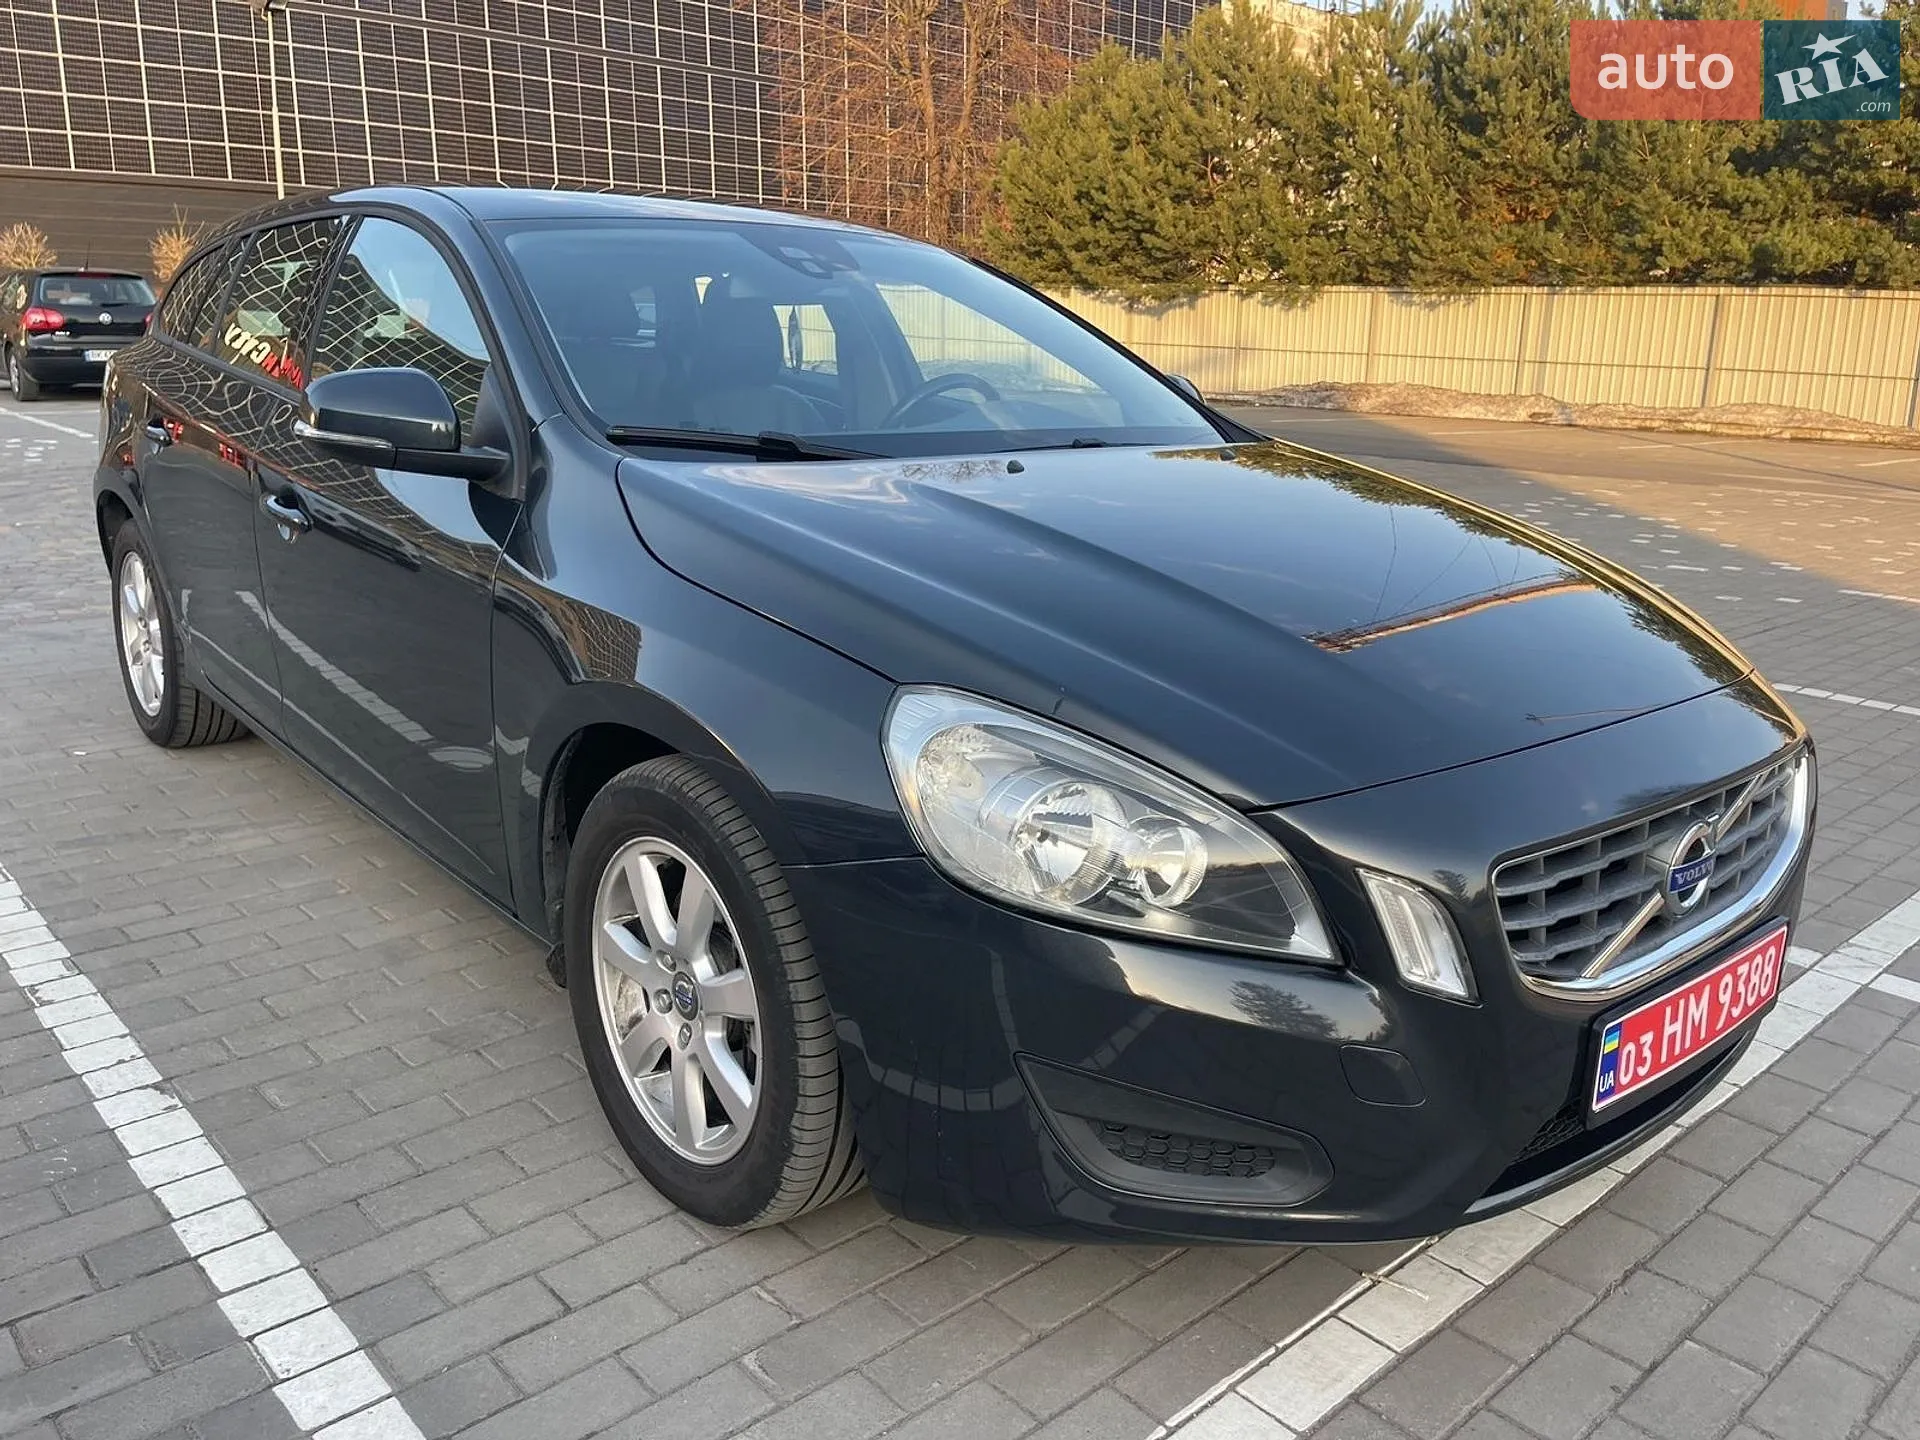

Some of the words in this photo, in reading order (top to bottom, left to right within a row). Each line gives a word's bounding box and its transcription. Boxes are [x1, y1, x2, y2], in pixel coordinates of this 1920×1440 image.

[1619, 1030, 1654, 1086] 03
[1660, 983, 1711, 1064] HM
[1715, 945, 1777, 1031] 9388
[1600, 1070, 1614, 1093] UA
